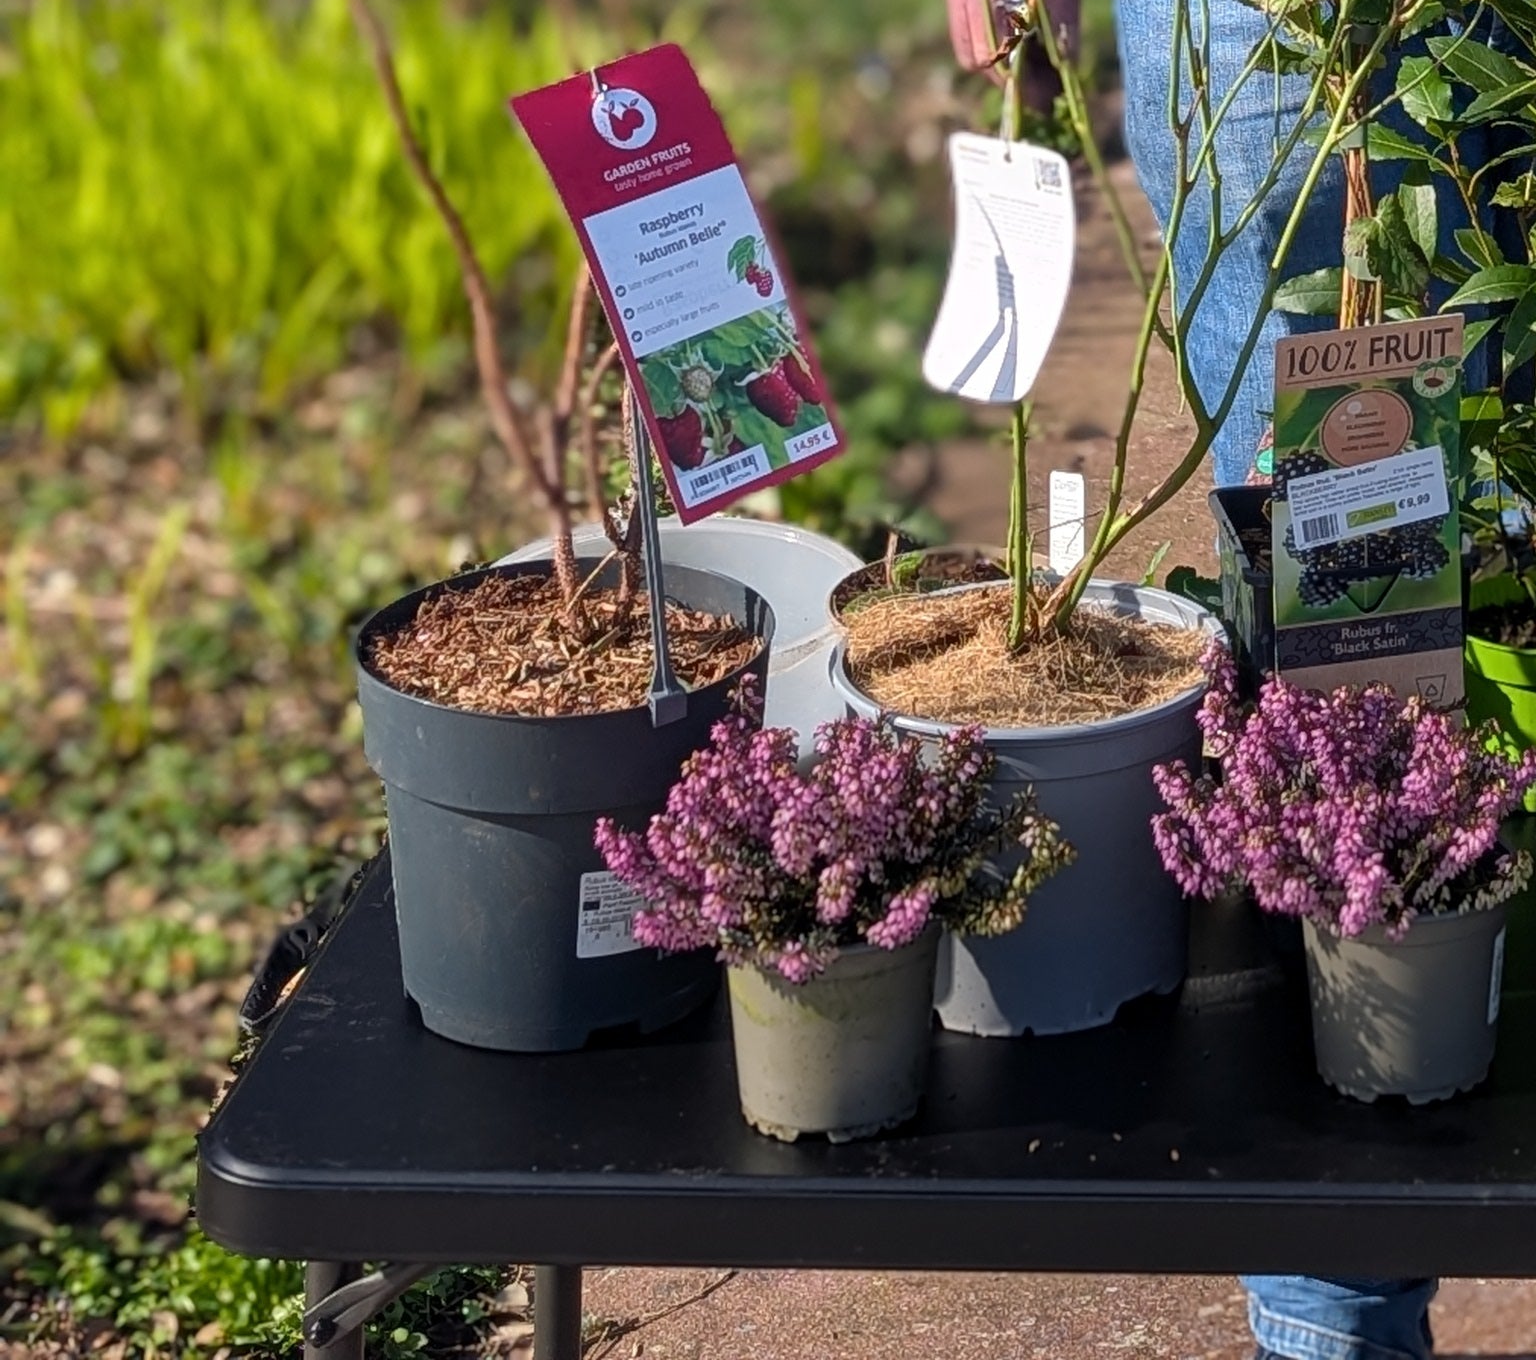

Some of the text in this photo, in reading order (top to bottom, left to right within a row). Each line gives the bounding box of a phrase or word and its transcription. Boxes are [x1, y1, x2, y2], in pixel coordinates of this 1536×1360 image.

[603, 142, 692, 182] GARDEN FRUITS
[614, 157, 693, 193] tasty home grown
[639, 202, 704, 236] Raspberry
[1286, 327, 1454, 378] 100% FRUIT
[1330, 632, 1409, 656] 'Black Satin'
[1341, 621, 1399, 640] Rubus fr.
